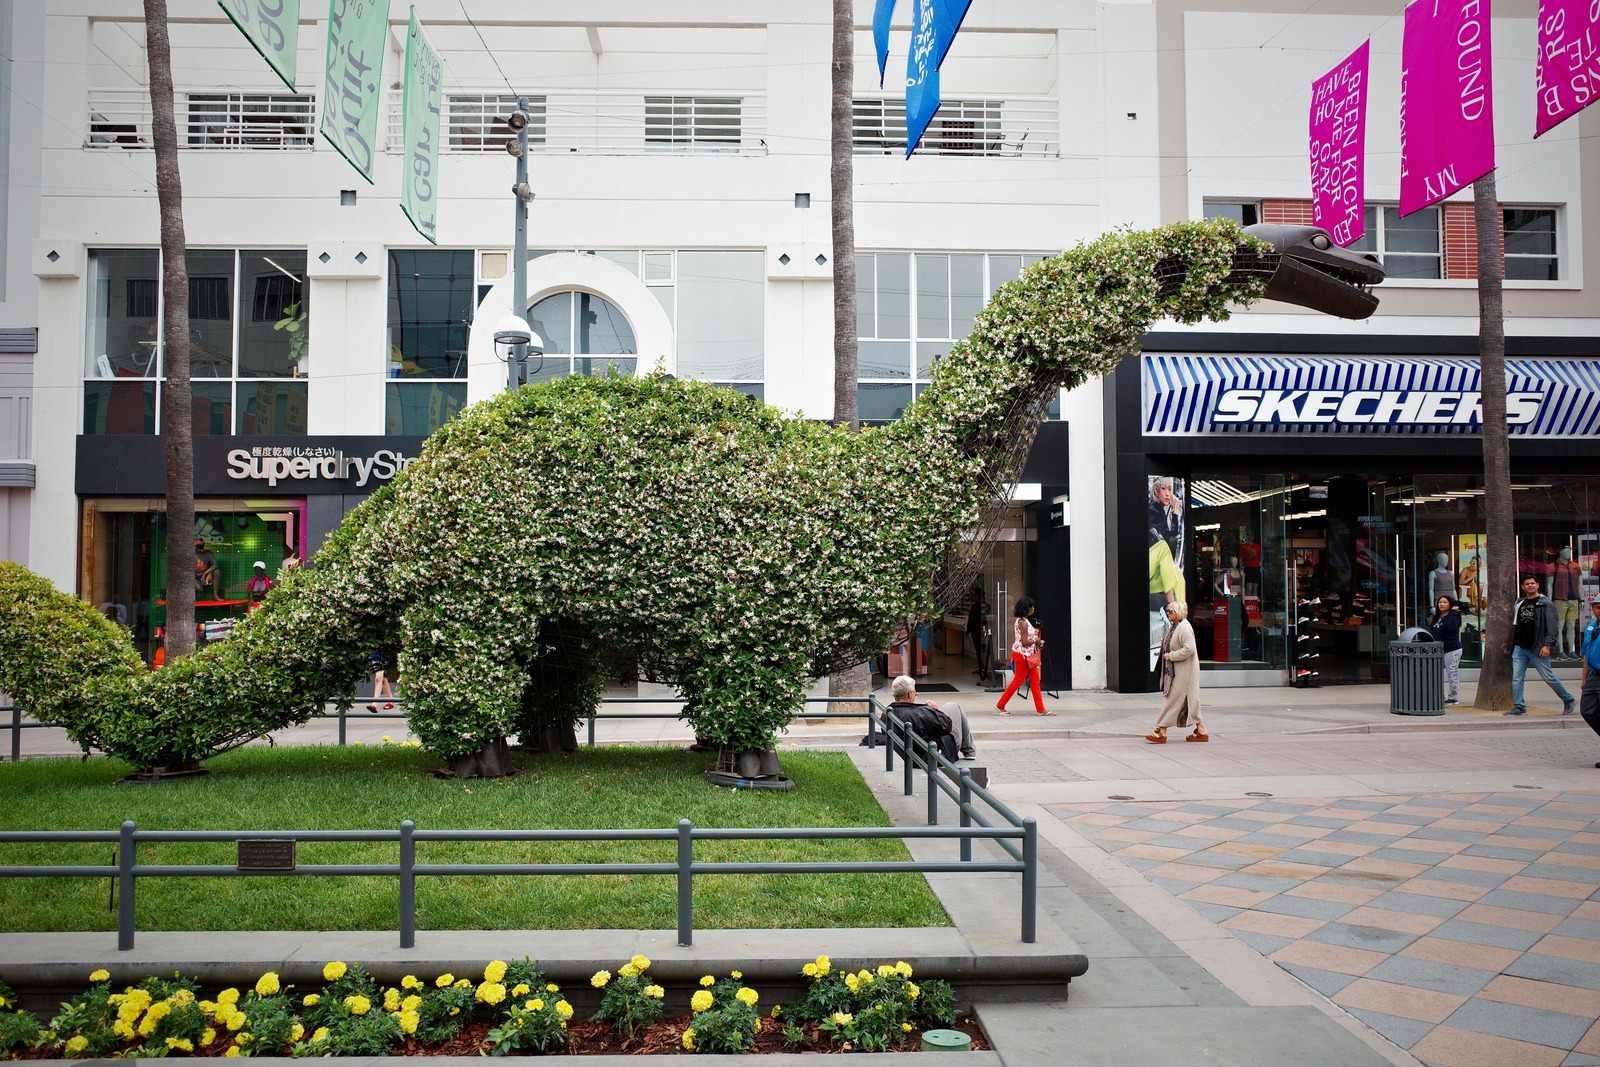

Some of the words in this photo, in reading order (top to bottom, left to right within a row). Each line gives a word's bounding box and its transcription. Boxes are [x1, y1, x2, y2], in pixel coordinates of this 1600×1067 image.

[1315, 62, 1352, 102] HAVE
[1457, 0, 1485, 121] FOUND
[1314, 97, 1350, 146] HOME
[1342, 70, 1361, 149] BEEN
[1310, 139, 1322, 222] BEING
[1320, 142, 1331, 194] GAY
[1331, 148, 1342, 206] FOR
[1424, 164, 1460, 202] MY
[1333, 155, 1358, 246] KICKED
[1213, 390, 1545, 424] SKECHERS
